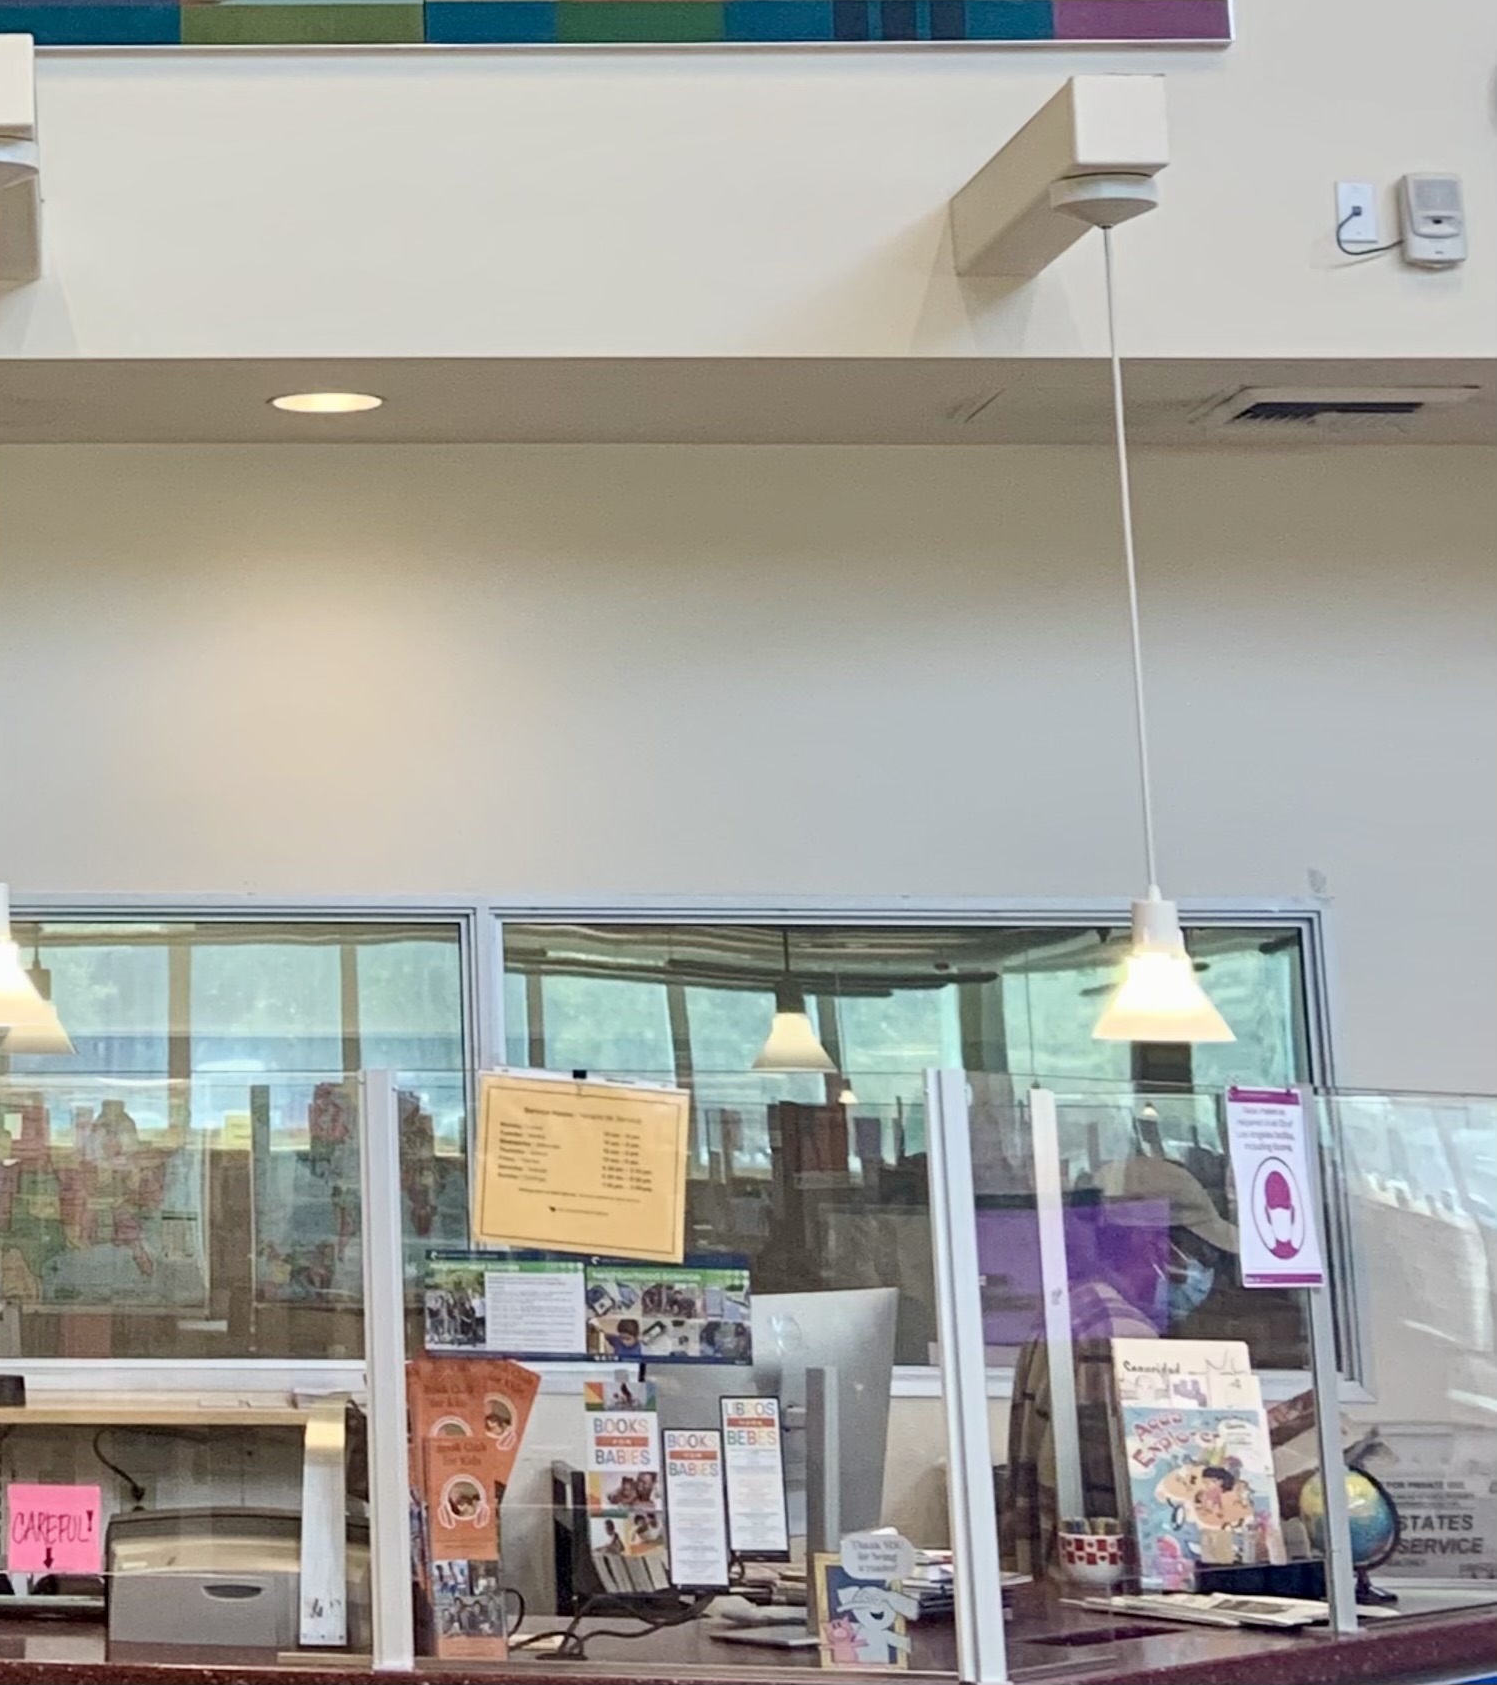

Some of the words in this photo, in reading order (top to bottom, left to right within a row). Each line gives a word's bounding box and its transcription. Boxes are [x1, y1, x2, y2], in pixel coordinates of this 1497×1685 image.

[725, 1401, 776, 1416] LIBROS
[593, 1418, 648, 1434] BOOKS
[667, 1433, 717, 1448] BOOKS
[726, 1430, 777, 1446] BEBES
[595, 1449, 651, 1465] BABIES
[669, 1462, 719, 1476] BABIES
[11, 1509, 94, 1545] CAREFUL!
[1399, 1514, 1473, 1531] STATES
[1397, 1537, 1483, 1555] SERVICE
